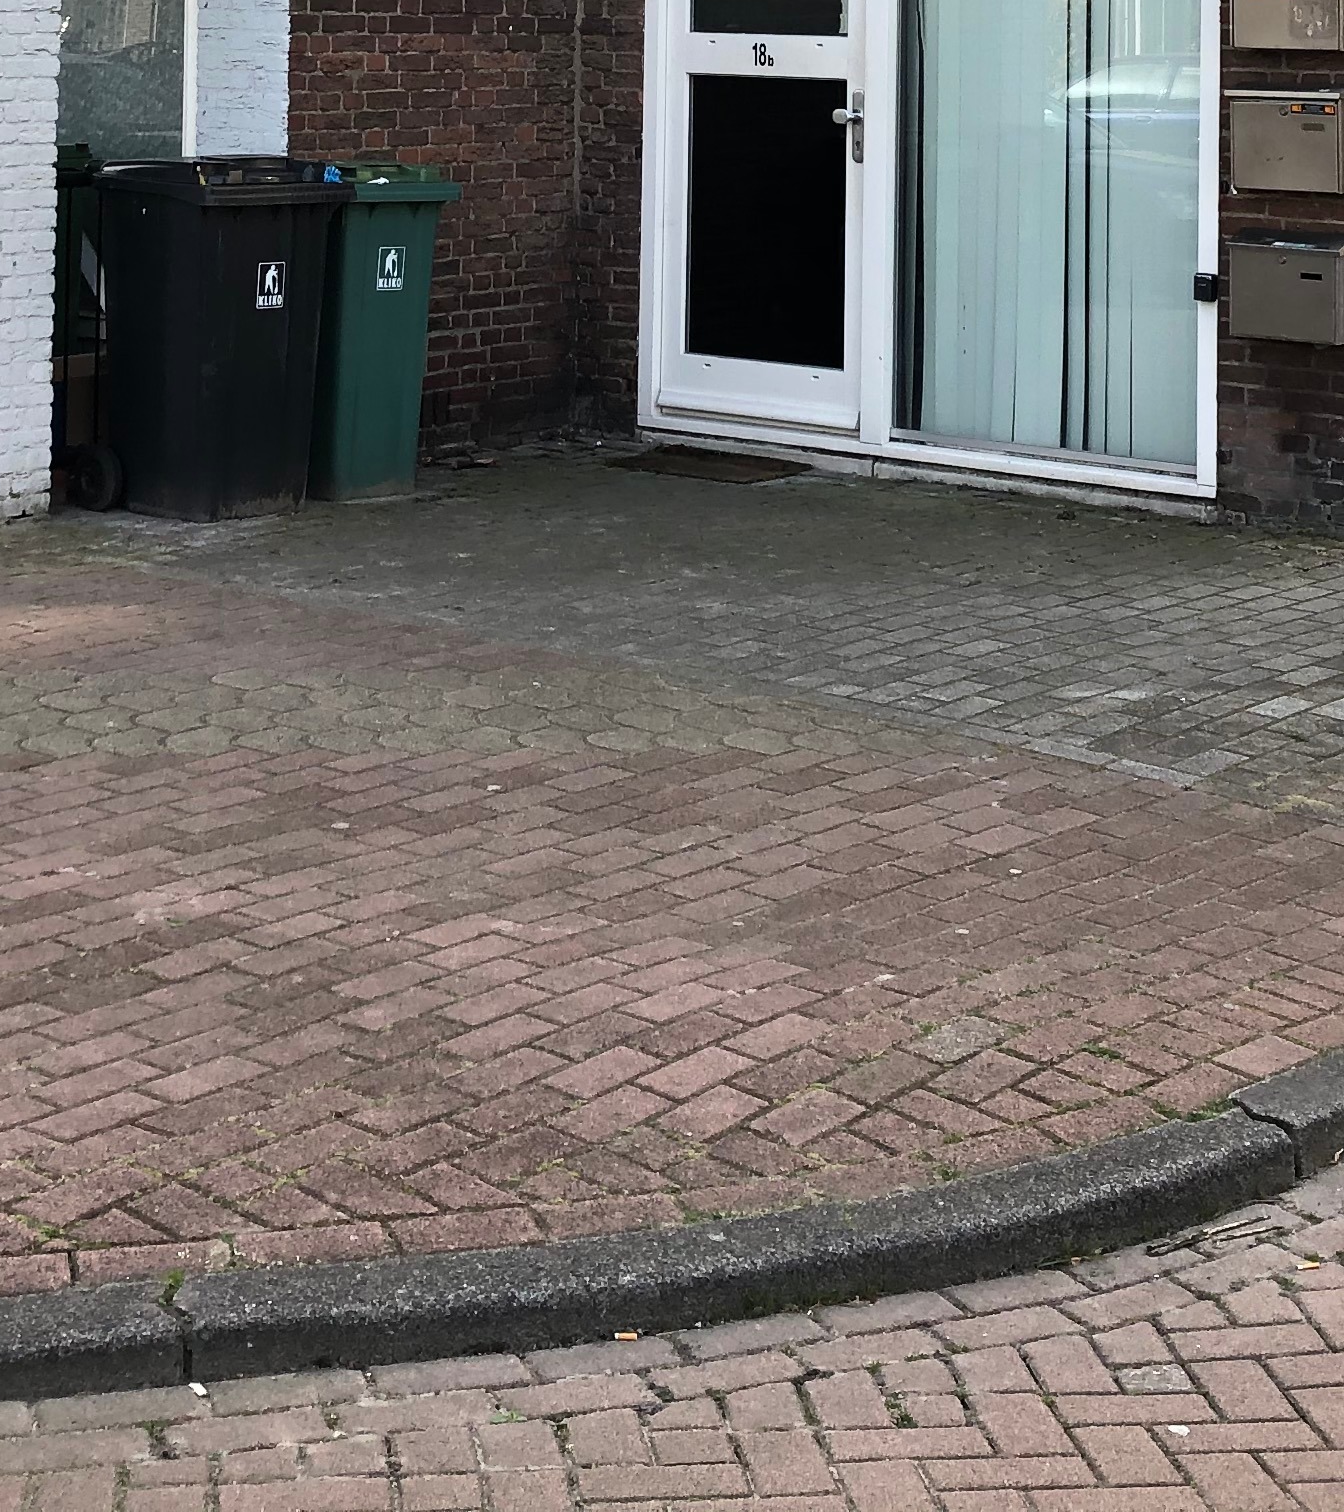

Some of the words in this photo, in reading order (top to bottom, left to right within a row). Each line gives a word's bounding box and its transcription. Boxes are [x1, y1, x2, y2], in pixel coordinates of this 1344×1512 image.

[752, 42, 774, 67] 18b
[379, 278, 402, 288] KLIKO
[258, 295, 283, 306] KLIKO
